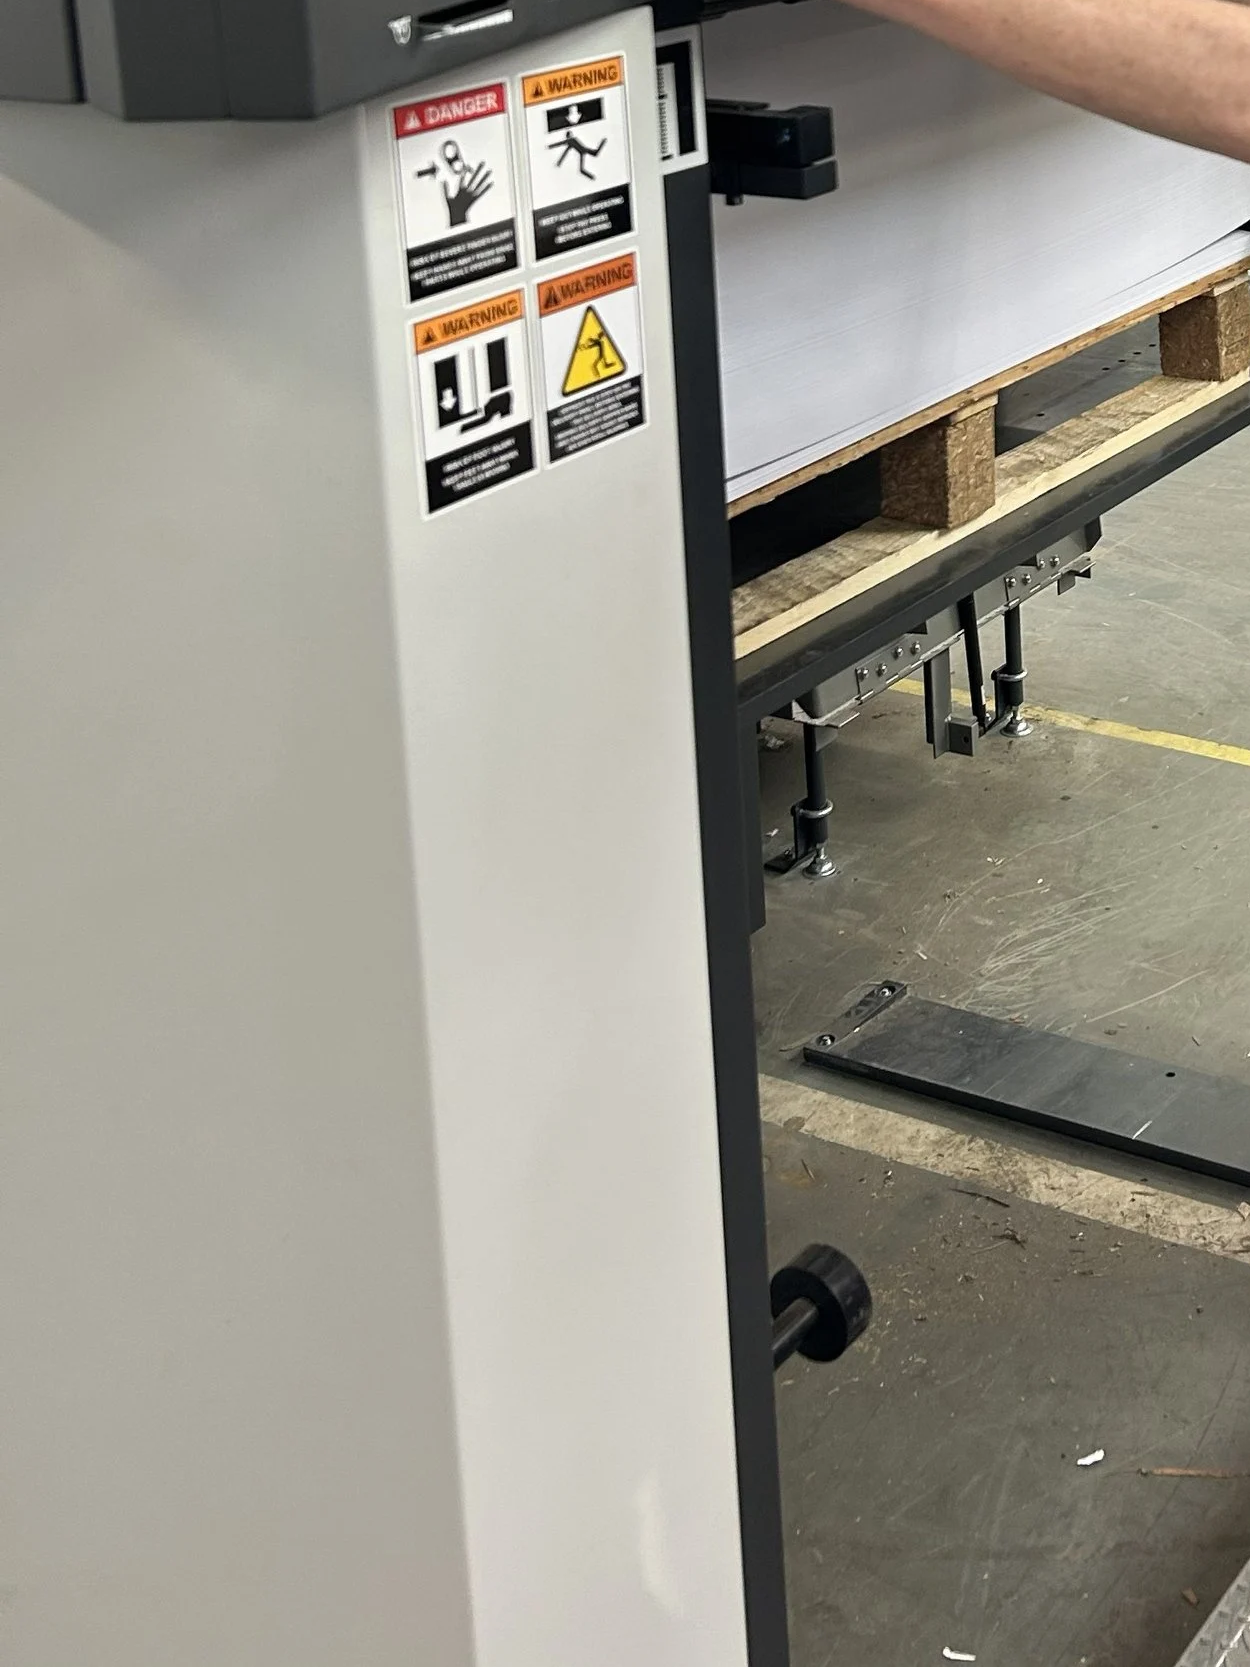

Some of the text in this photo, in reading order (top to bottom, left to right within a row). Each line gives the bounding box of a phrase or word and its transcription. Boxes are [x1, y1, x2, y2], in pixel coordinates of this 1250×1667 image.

[548, 65, 619, 95] WARNING
[424, 91, 499, 125] DANGER
[561, 262, 633, 300] WARNING
[442, 297, 518, 336] WARNING
